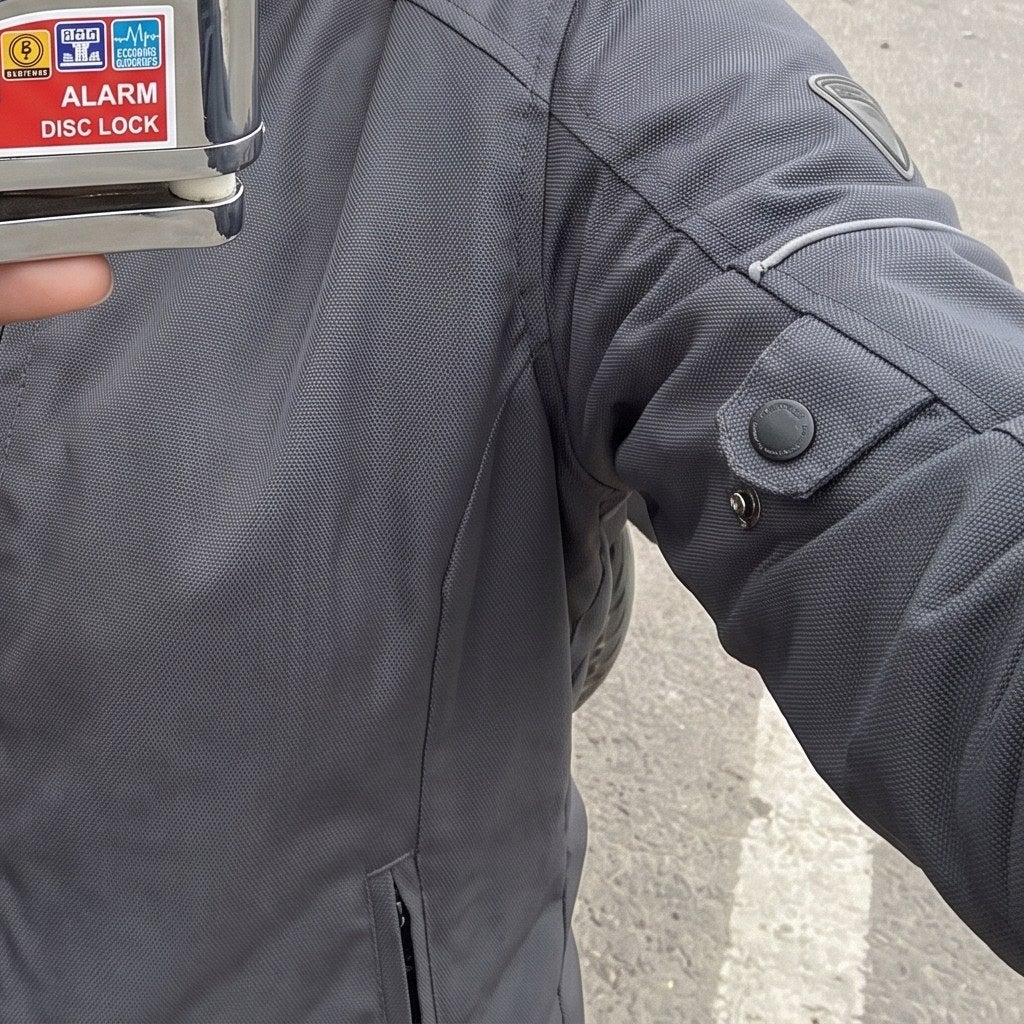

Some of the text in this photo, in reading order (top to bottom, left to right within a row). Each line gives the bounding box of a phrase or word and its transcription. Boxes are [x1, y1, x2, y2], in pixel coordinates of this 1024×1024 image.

[61, 82, 158, 108] ALARM
[41, 115, 159, 139] DISC LOCK
